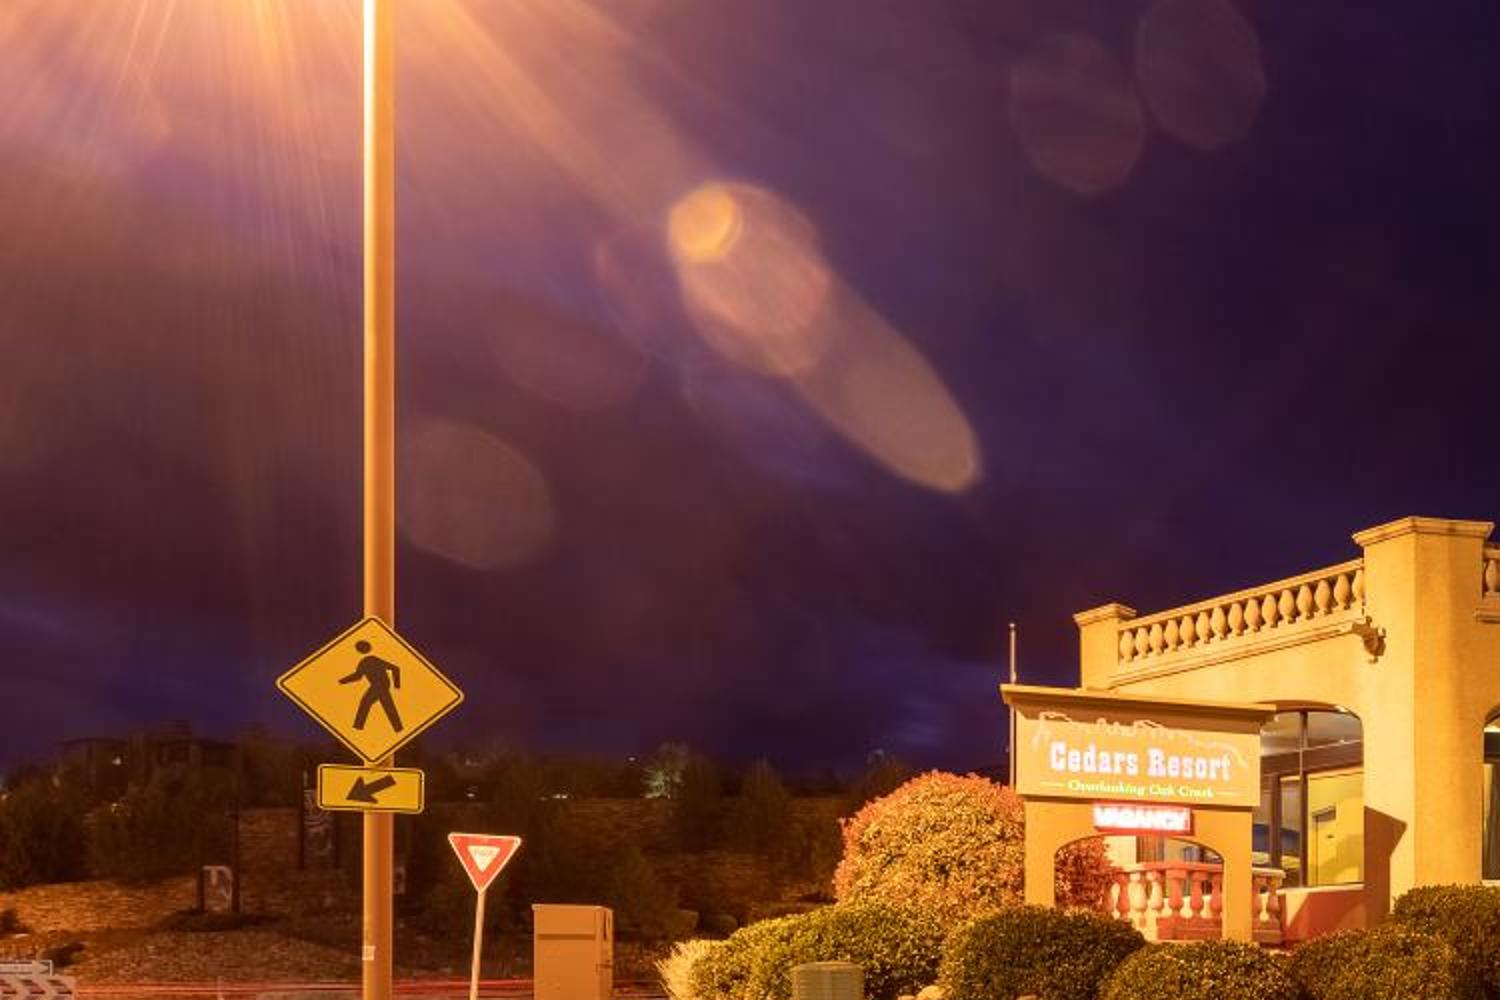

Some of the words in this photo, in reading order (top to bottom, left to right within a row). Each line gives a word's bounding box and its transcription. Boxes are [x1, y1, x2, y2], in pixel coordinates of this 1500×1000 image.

[1051, 742, 1139, 776] Cedars
[1148, 747, 1231, 780] Resort
[1067, 779, 1145, 797] Overlooking
[1150, 783, 1175, 797] Oak
[1178, 784, 1214, 799] Creek
